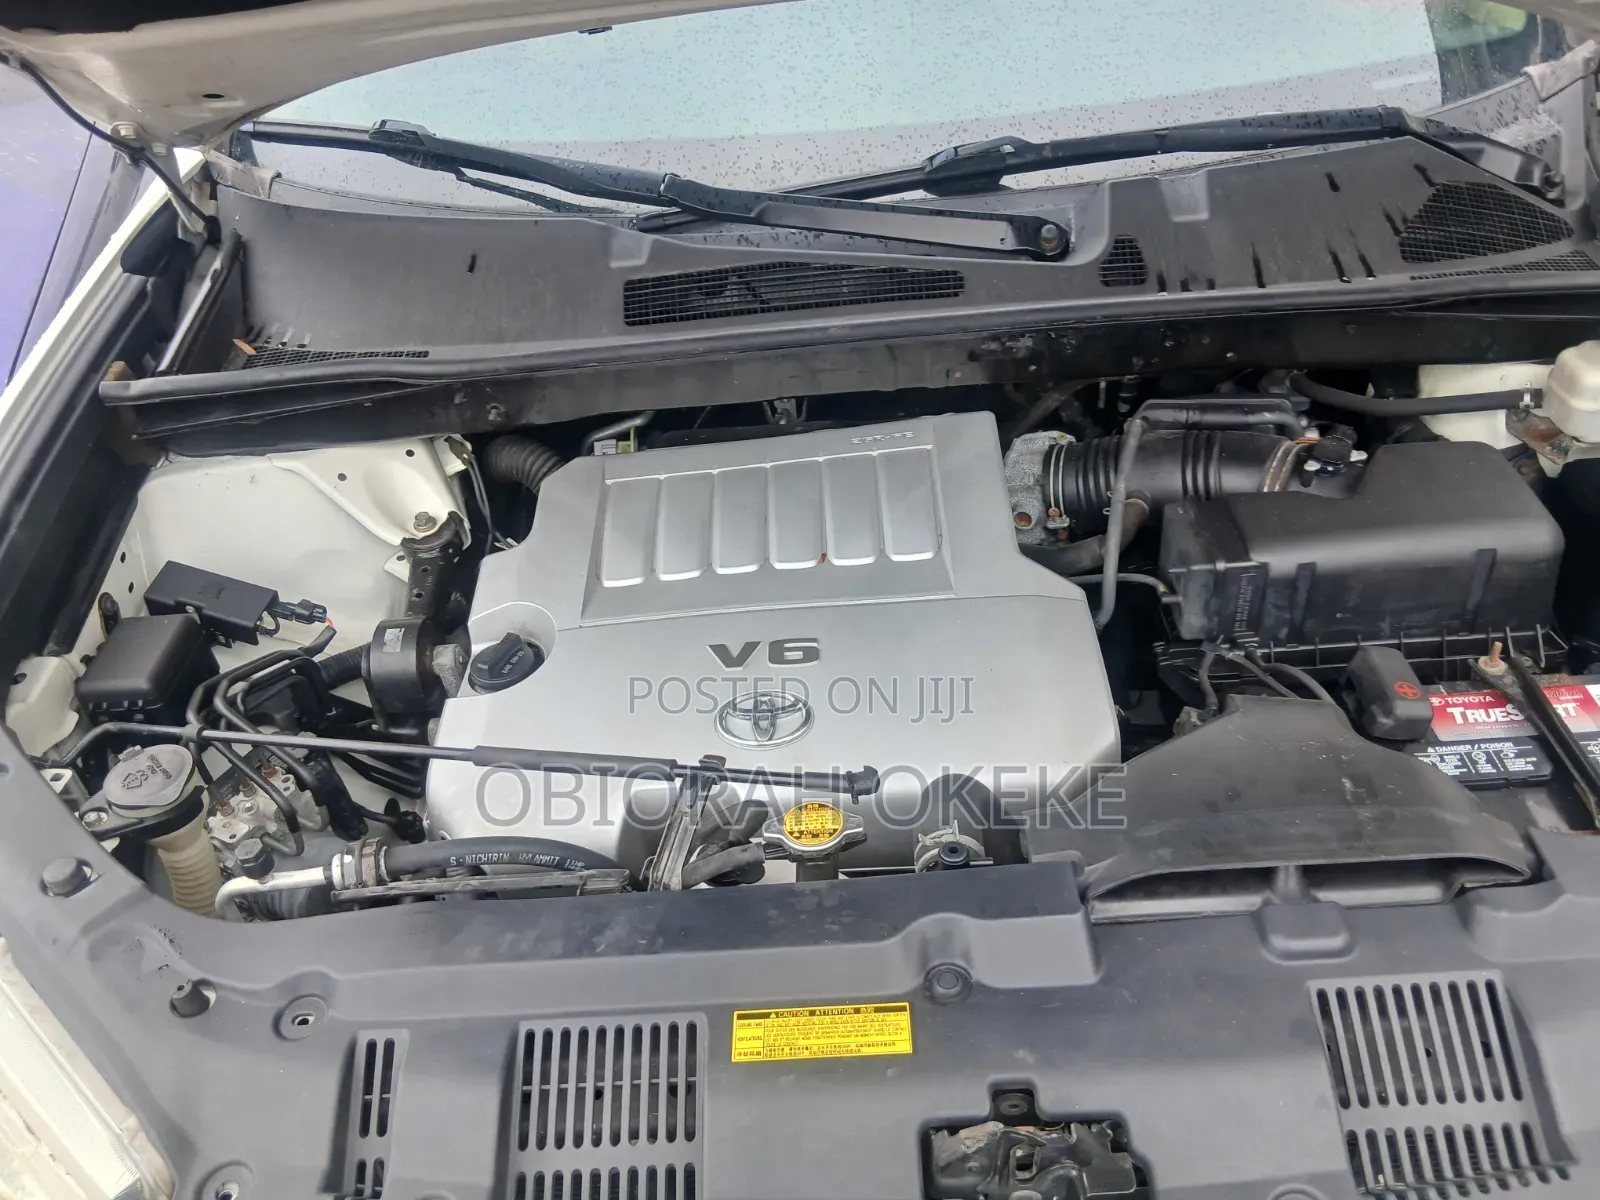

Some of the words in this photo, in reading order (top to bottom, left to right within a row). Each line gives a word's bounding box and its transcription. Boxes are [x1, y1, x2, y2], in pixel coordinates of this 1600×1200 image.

[706, 637, 820, 672] V6
[1446, 695, 1495, 704] TOYOTA
[1435, 744, 1473, 752] DANGER
[1480, 741, 1514, 750] POISON
[778, 1010, 810, 1018] CAUTION
[815, 1007, 855, 1016] ATTENTION
